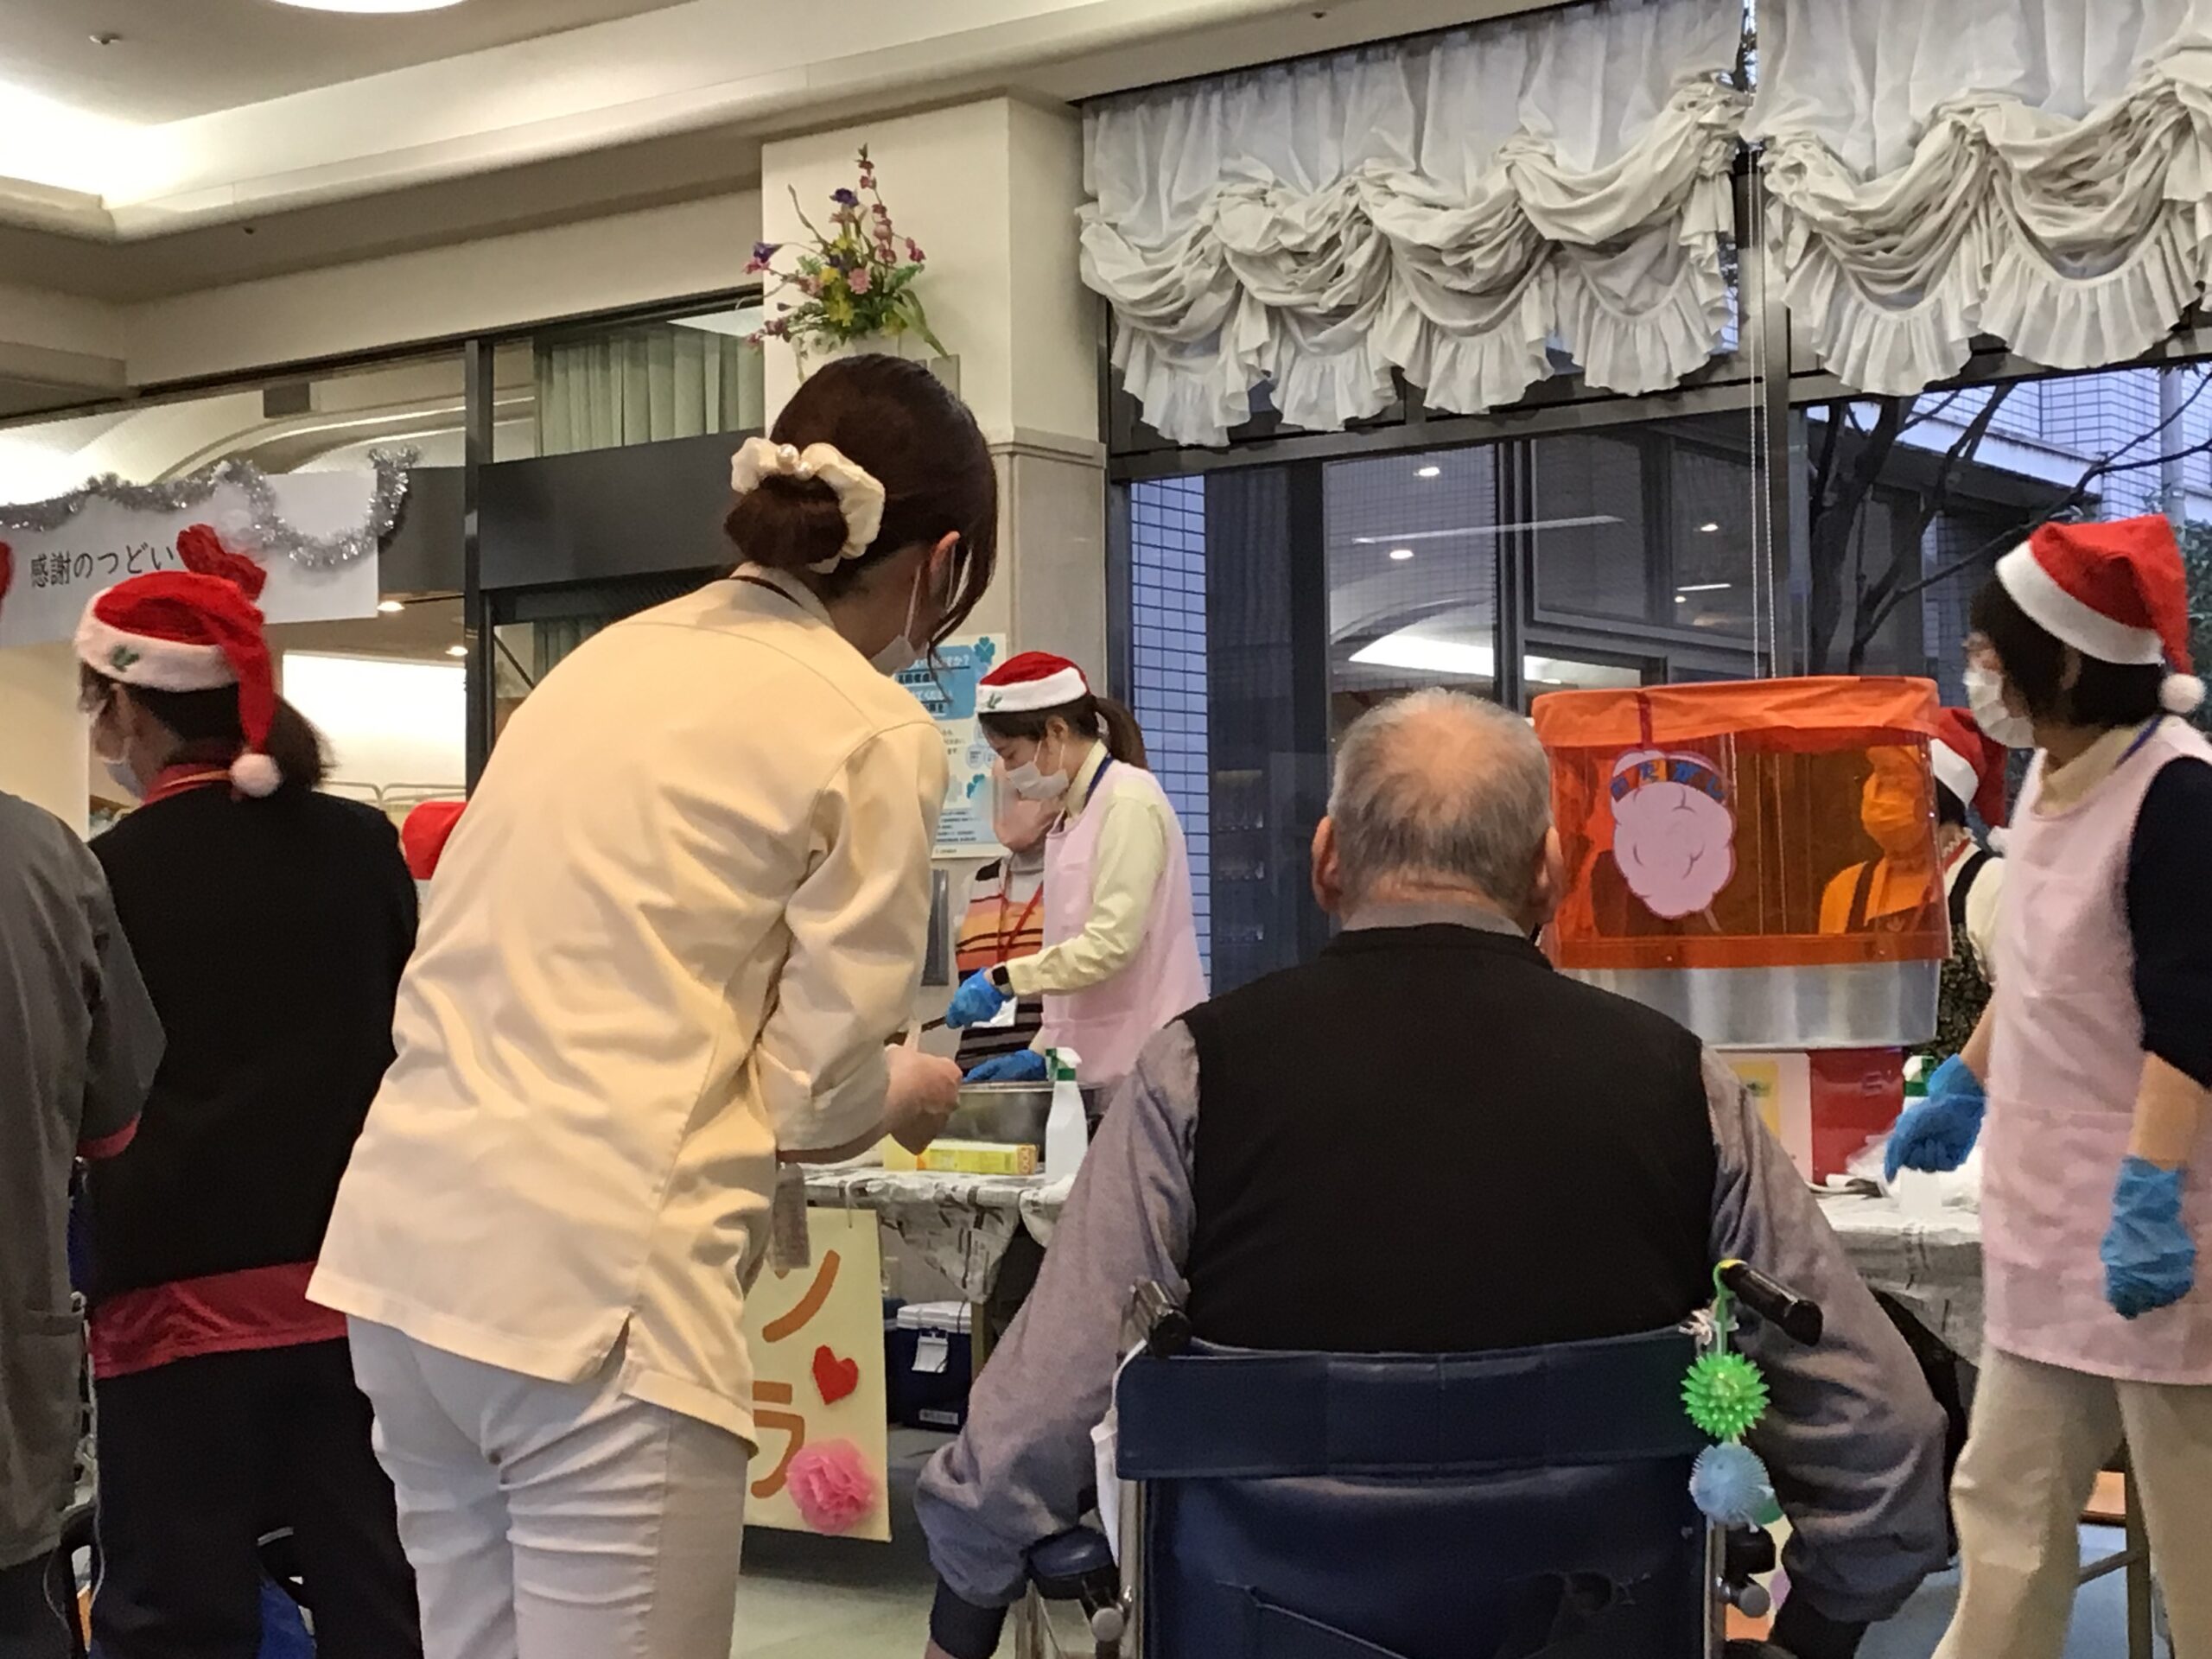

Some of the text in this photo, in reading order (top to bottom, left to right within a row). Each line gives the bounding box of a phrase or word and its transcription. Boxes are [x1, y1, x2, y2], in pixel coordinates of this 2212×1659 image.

[30, 542, 175, 588] 感謝のつどい
